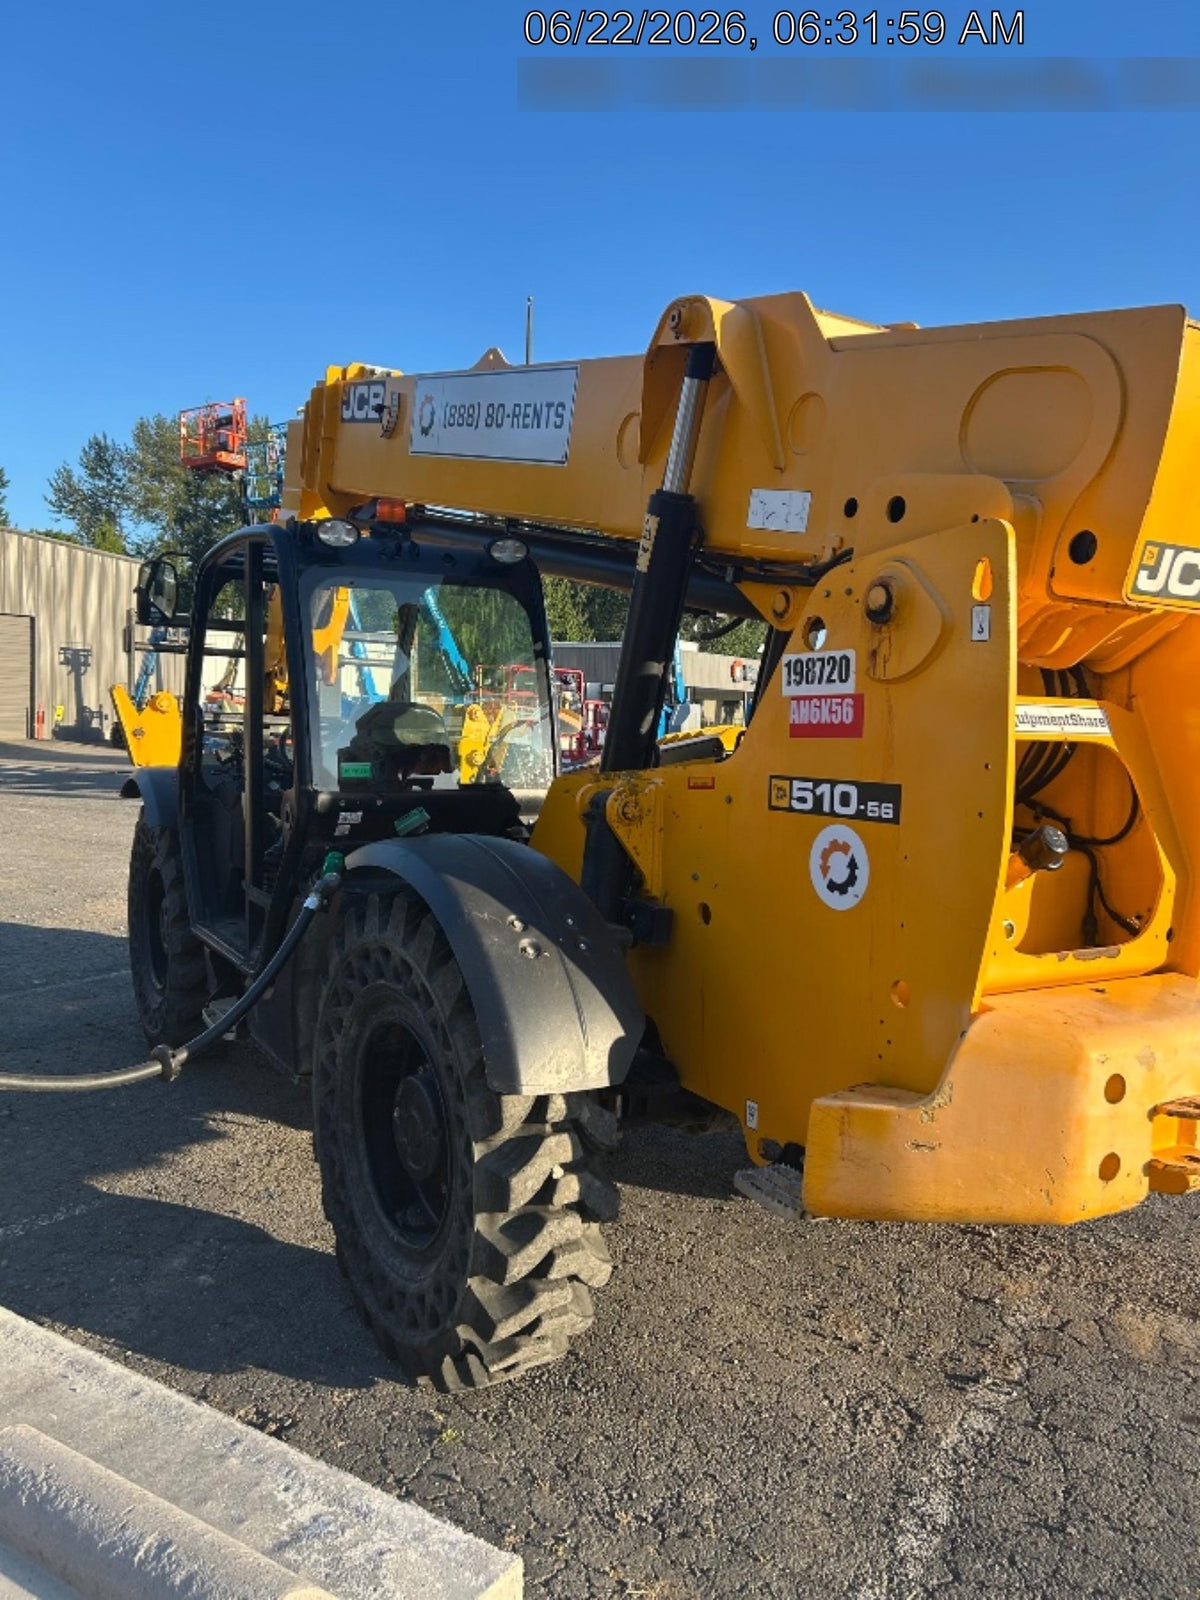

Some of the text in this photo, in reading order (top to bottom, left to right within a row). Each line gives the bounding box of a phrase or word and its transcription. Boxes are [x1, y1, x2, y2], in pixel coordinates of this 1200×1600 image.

[343, 384, 385, 419] JCB
[443, 401, 566, 430] (888) 80-RENTS
[784, 654, 851, 687] 198720
[791, 779, 894, 819] 510-56
